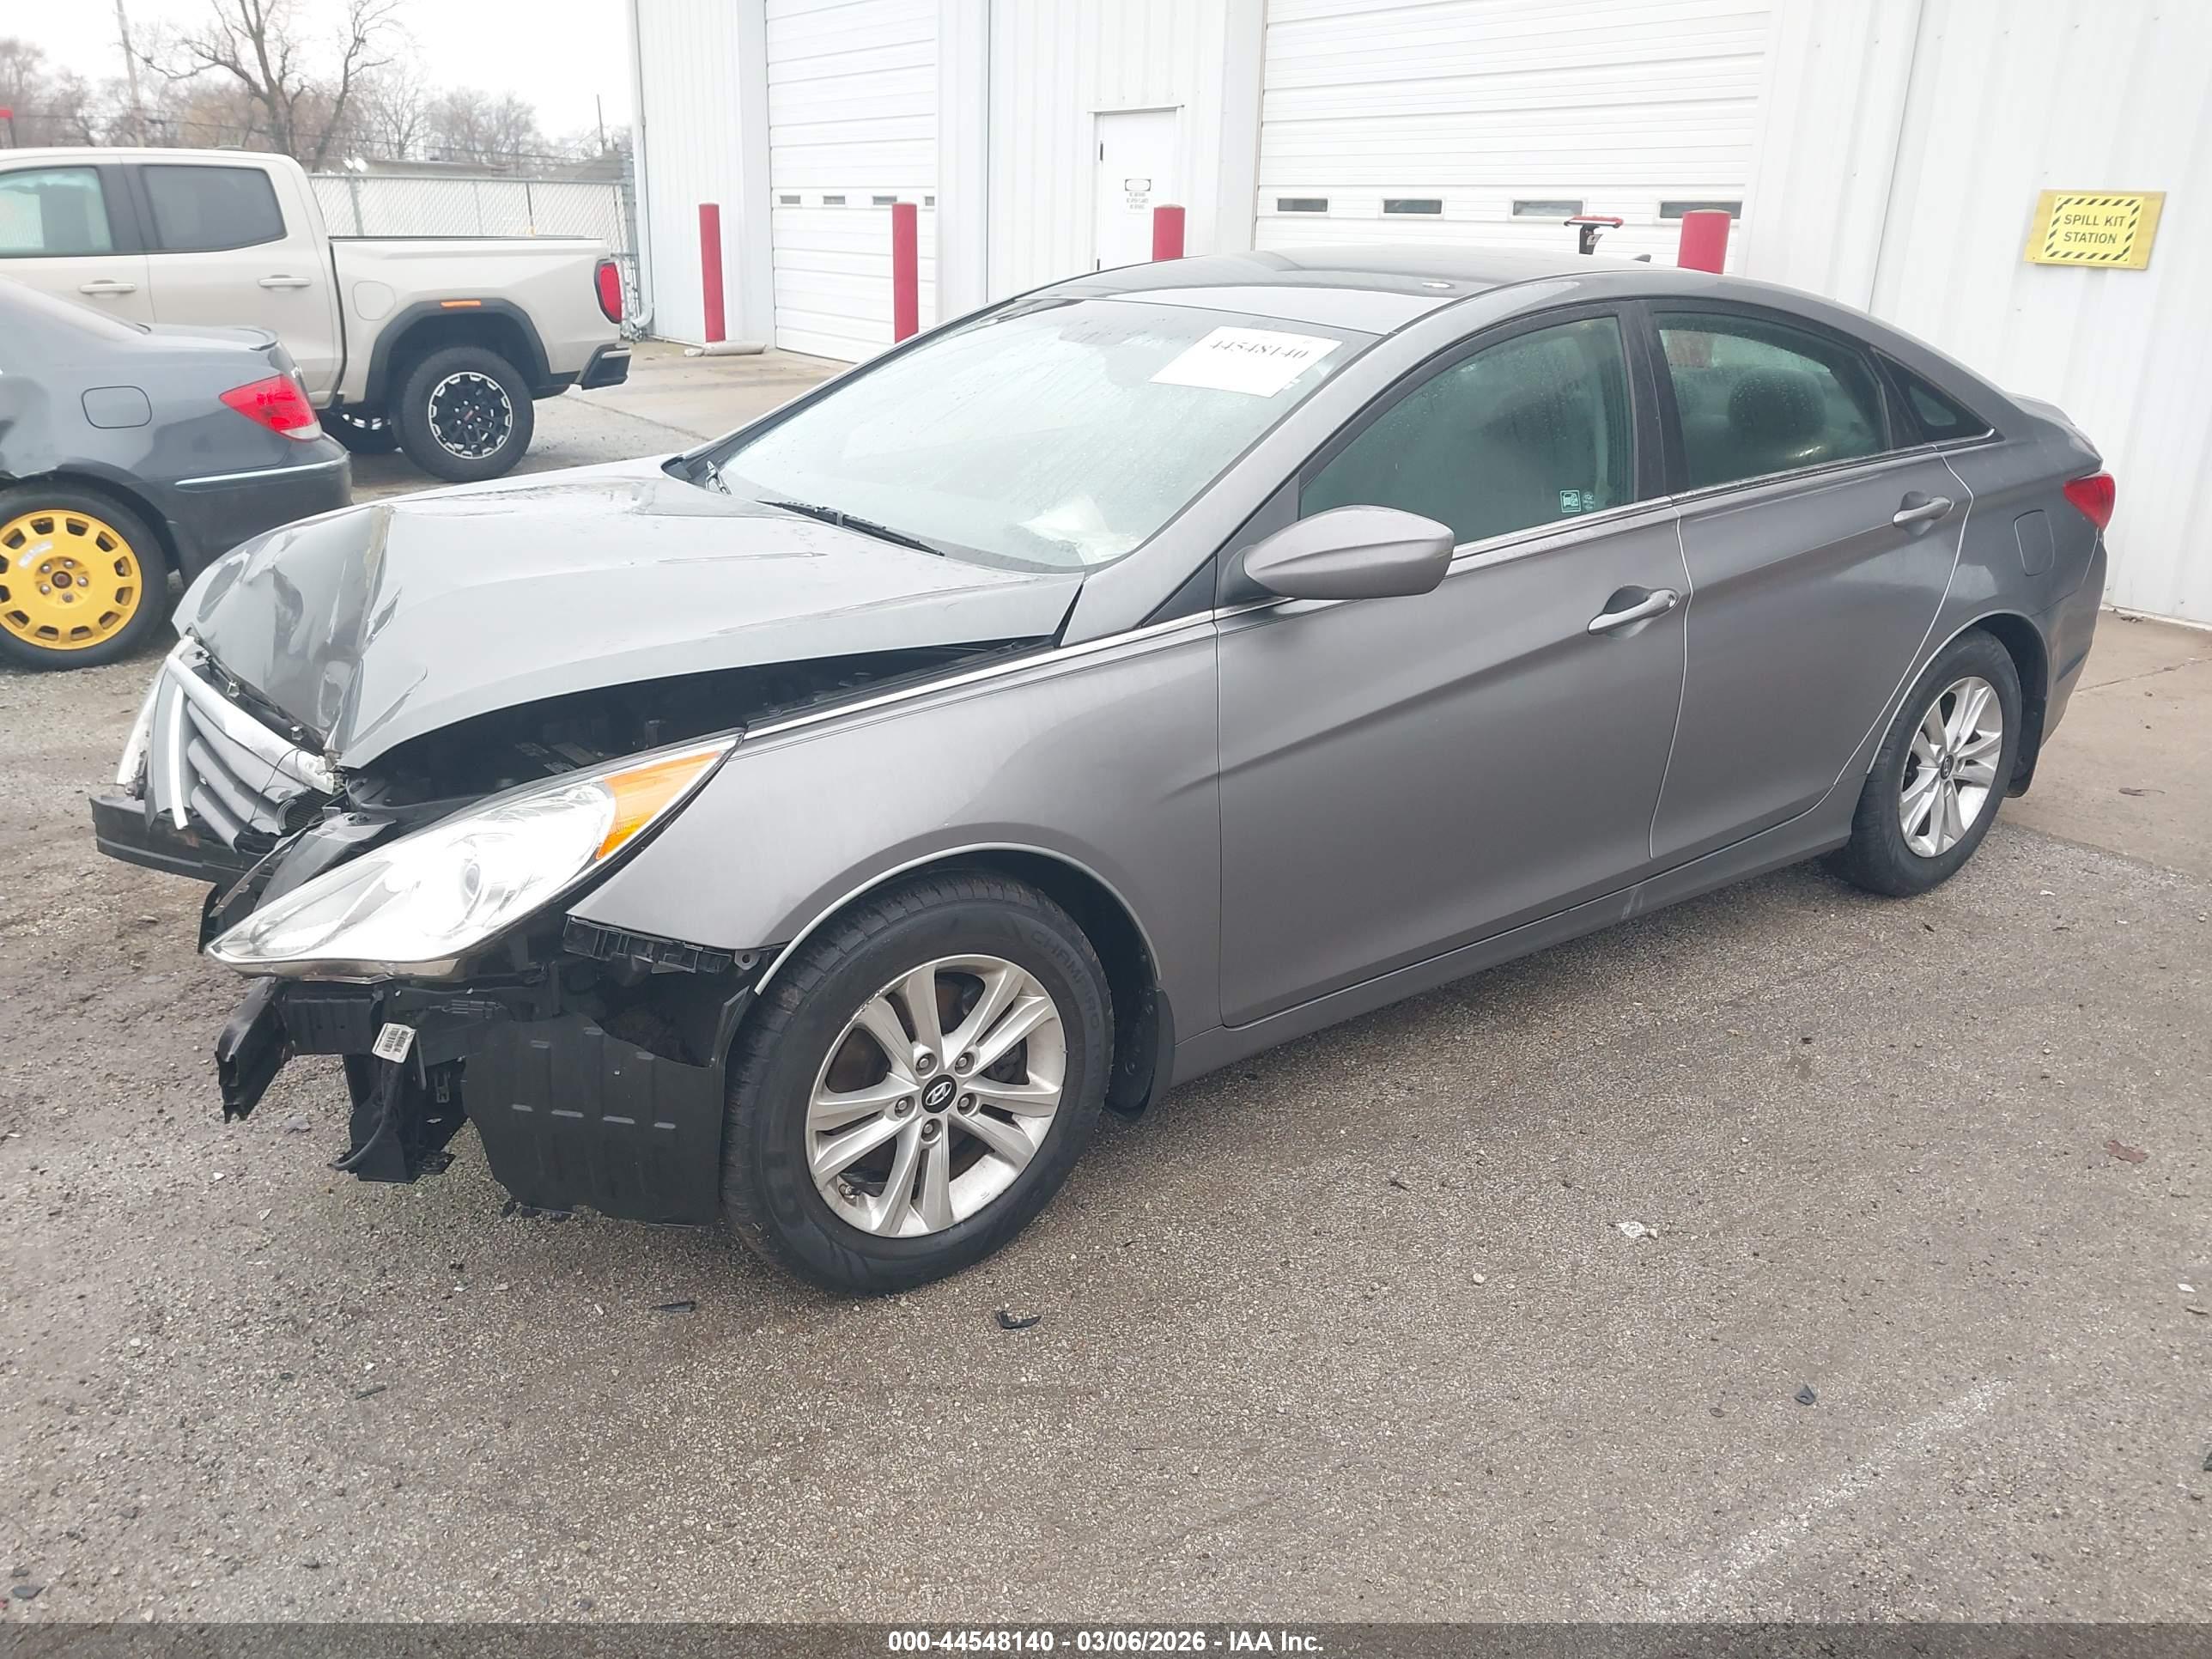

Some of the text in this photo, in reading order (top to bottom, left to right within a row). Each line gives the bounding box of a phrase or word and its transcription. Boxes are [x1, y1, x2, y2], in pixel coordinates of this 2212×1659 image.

[2064, 215, 2125, 227] SPILL KIT
[2063, 232, 2117, 244] STATION
[1210, 341, 1309, 359] 44548140
